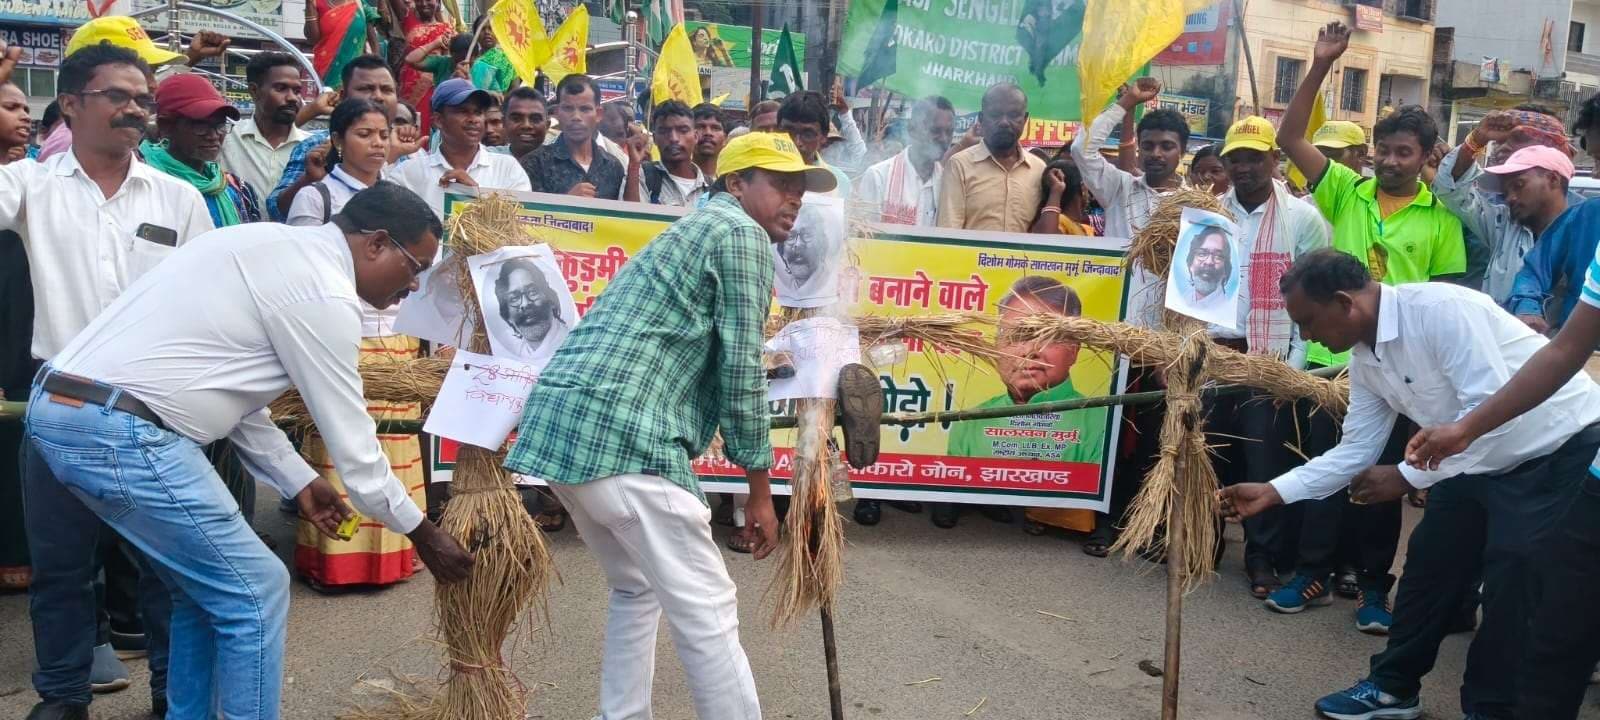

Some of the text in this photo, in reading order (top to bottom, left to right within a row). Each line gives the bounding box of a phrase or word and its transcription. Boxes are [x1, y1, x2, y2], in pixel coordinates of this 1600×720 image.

[22, 31, 60, 48] SHOE
[893, 24, 946, 55] OKARO
[949, 36, 1024, 66] DISTRICT
[869, 271, 933, 308] बनाने
[939, 274, 988, 312] वाले
[984, 427, 1048, 438] सालखन
[921, 460, 972, 481] जोन,
[979, 466, 1072, 485] झारखण्ड
